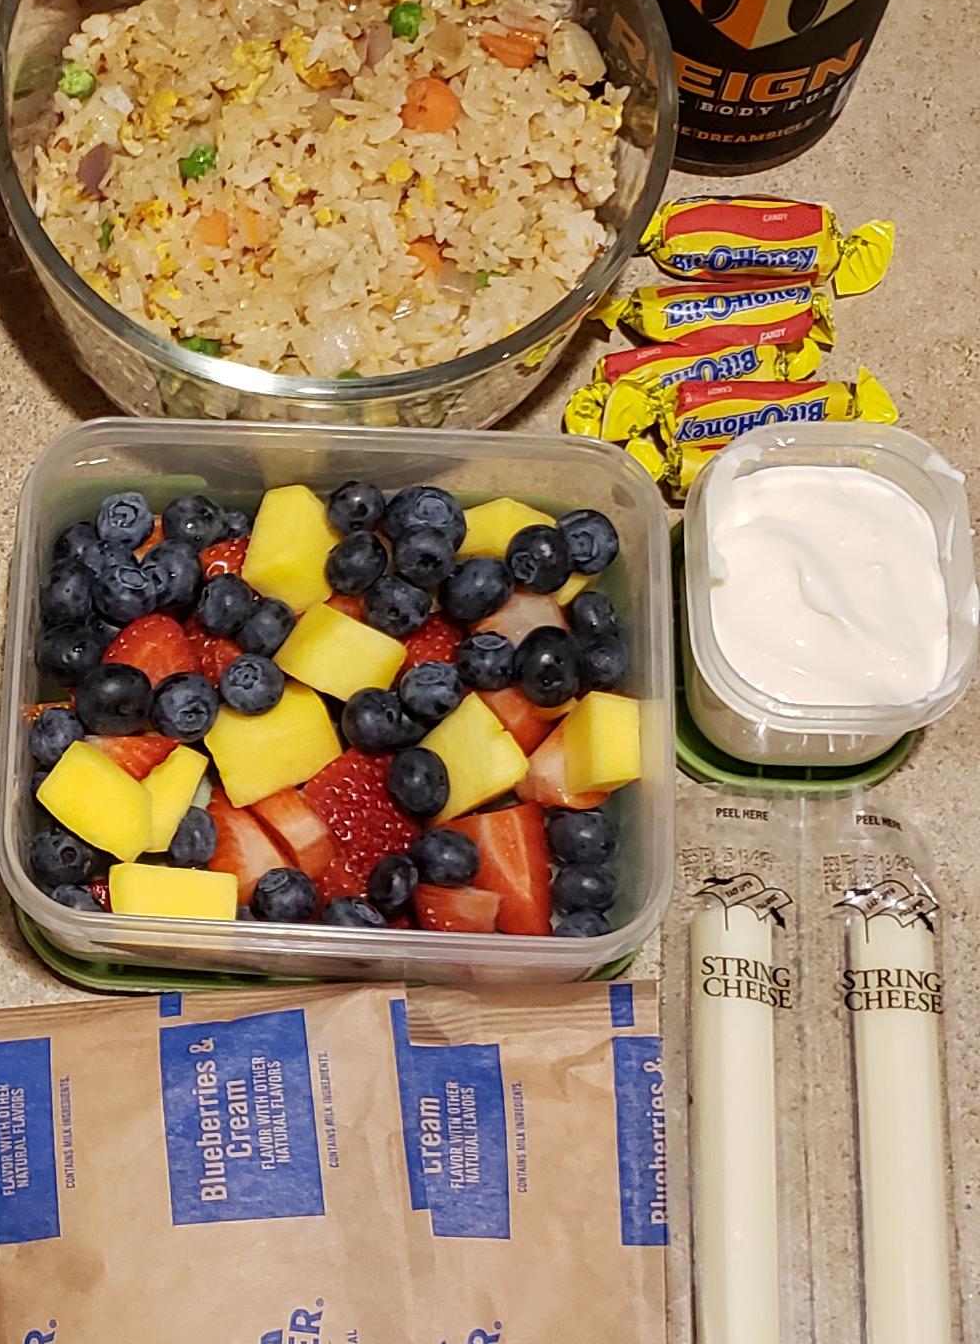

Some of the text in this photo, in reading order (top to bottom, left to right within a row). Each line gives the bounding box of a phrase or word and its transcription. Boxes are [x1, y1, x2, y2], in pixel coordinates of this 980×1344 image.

[700, 101, 773, 117] BODY
[763, 214, 788, 223] CANDY
[760, 328, 786, 341] CANDY
[716, 808, 769, 821] PEEL HERE
[856, 815, 880, 826] PEEL
[701, 956, 791, 988] STRING
[843, 969, 941, 993] STRING
[703, 976, 793, 1009] CHEESE
[844, 991, 944, 1014] CHEESE
[189, 1037, 228, 1201] Blueberries &
[225, 1079, 252, 1159] Cream
[252, 1056, 275, 1170] FLAVOR WITH OTHER
[267, 1060, 291, 1164] NATURAL FLAVORS
[0, 1121, 12, 1153] WITH
[11, 1088, 29, 1188] NATURAL FLAVORS
[446, 1081, 465, 1189] FLAVOR WITH OTHER
[461, 1086, 480, 1183] NATURAL FLAVORS
[1, 1154, 15, 1196] FLAVOR
